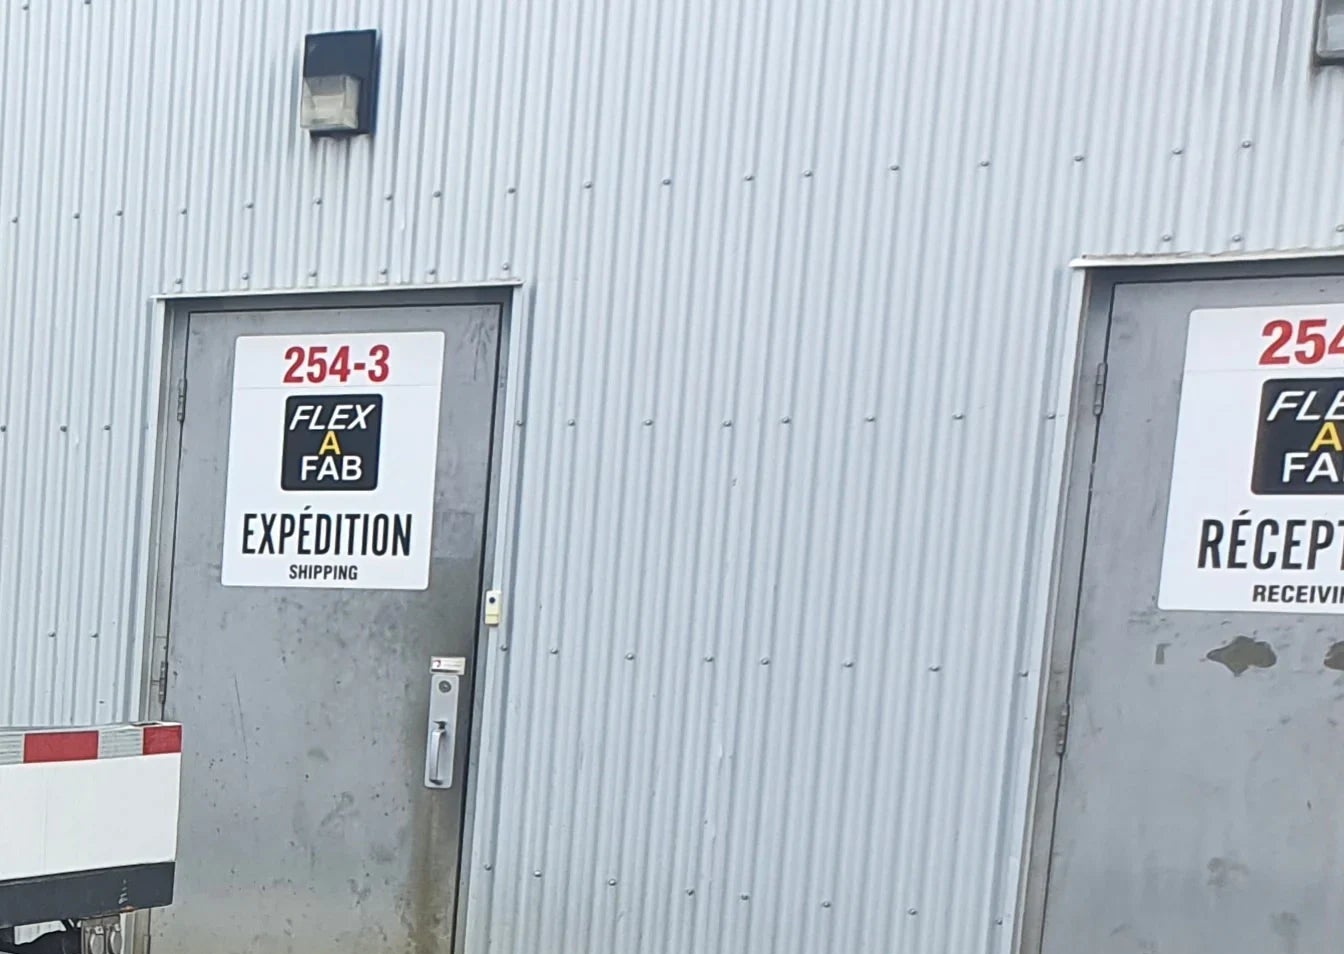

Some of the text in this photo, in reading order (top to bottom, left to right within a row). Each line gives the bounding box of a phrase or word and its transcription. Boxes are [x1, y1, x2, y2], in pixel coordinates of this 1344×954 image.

[283, 344, 390, 383] 254-3
[289, 404, 375, 430] FLEX
[318, 430, 341, 455] A
[1310, 421, 1342, 451] A
[300, 455, 362, 481] FAB
[1282, 452, 1344, 482] FA
[242, 505, 412, 556] EXPÉDITION
[289, 564, 358, 580] SHIPPING
